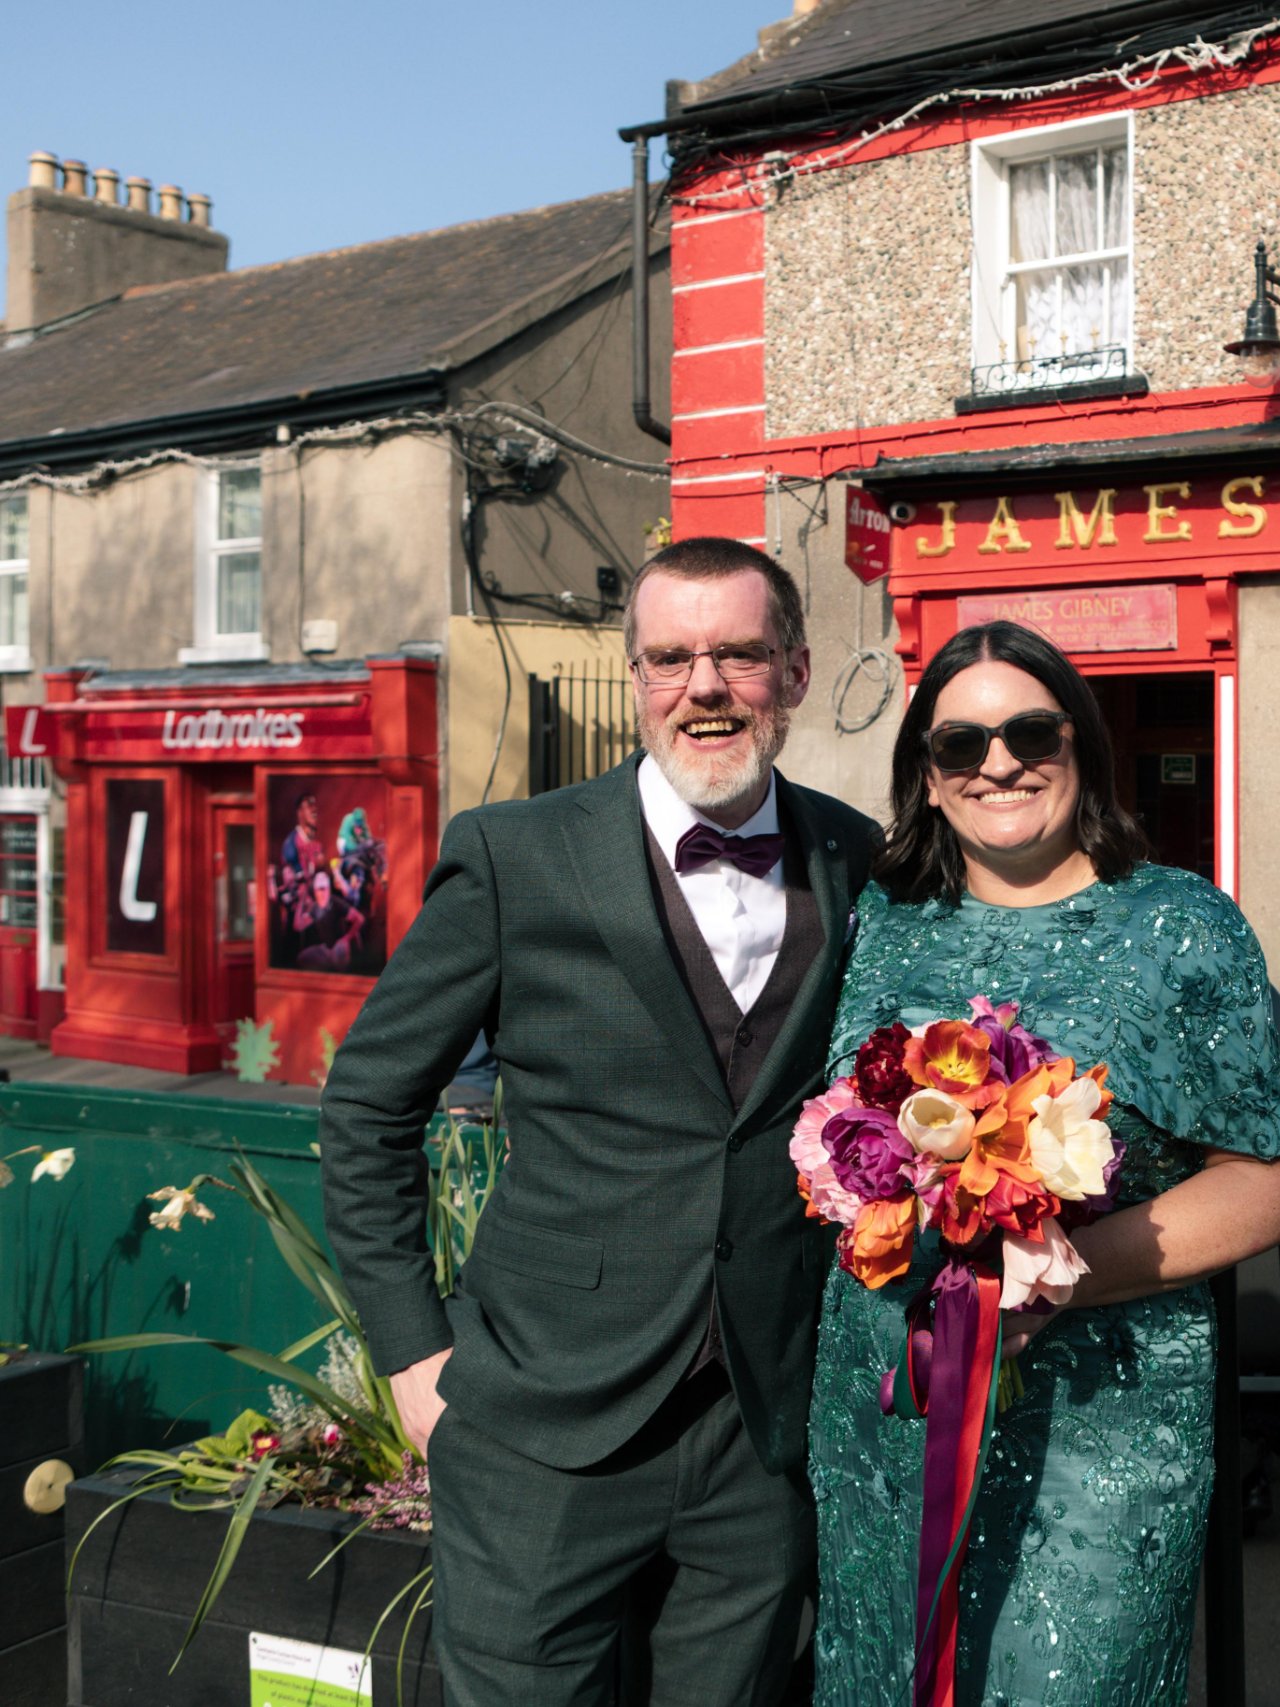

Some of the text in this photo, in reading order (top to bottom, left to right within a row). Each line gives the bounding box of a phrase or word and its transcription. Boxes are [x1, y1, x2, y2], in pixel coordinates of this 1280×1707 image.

[916, 476, 1267, 558] JAMES
[1059, 596, 1134, 619] GIBNEY
[19, 708, 47, 754] L
[162, 708, 305, 748] Ladbrokes
[119, 811, 156, 921] L
